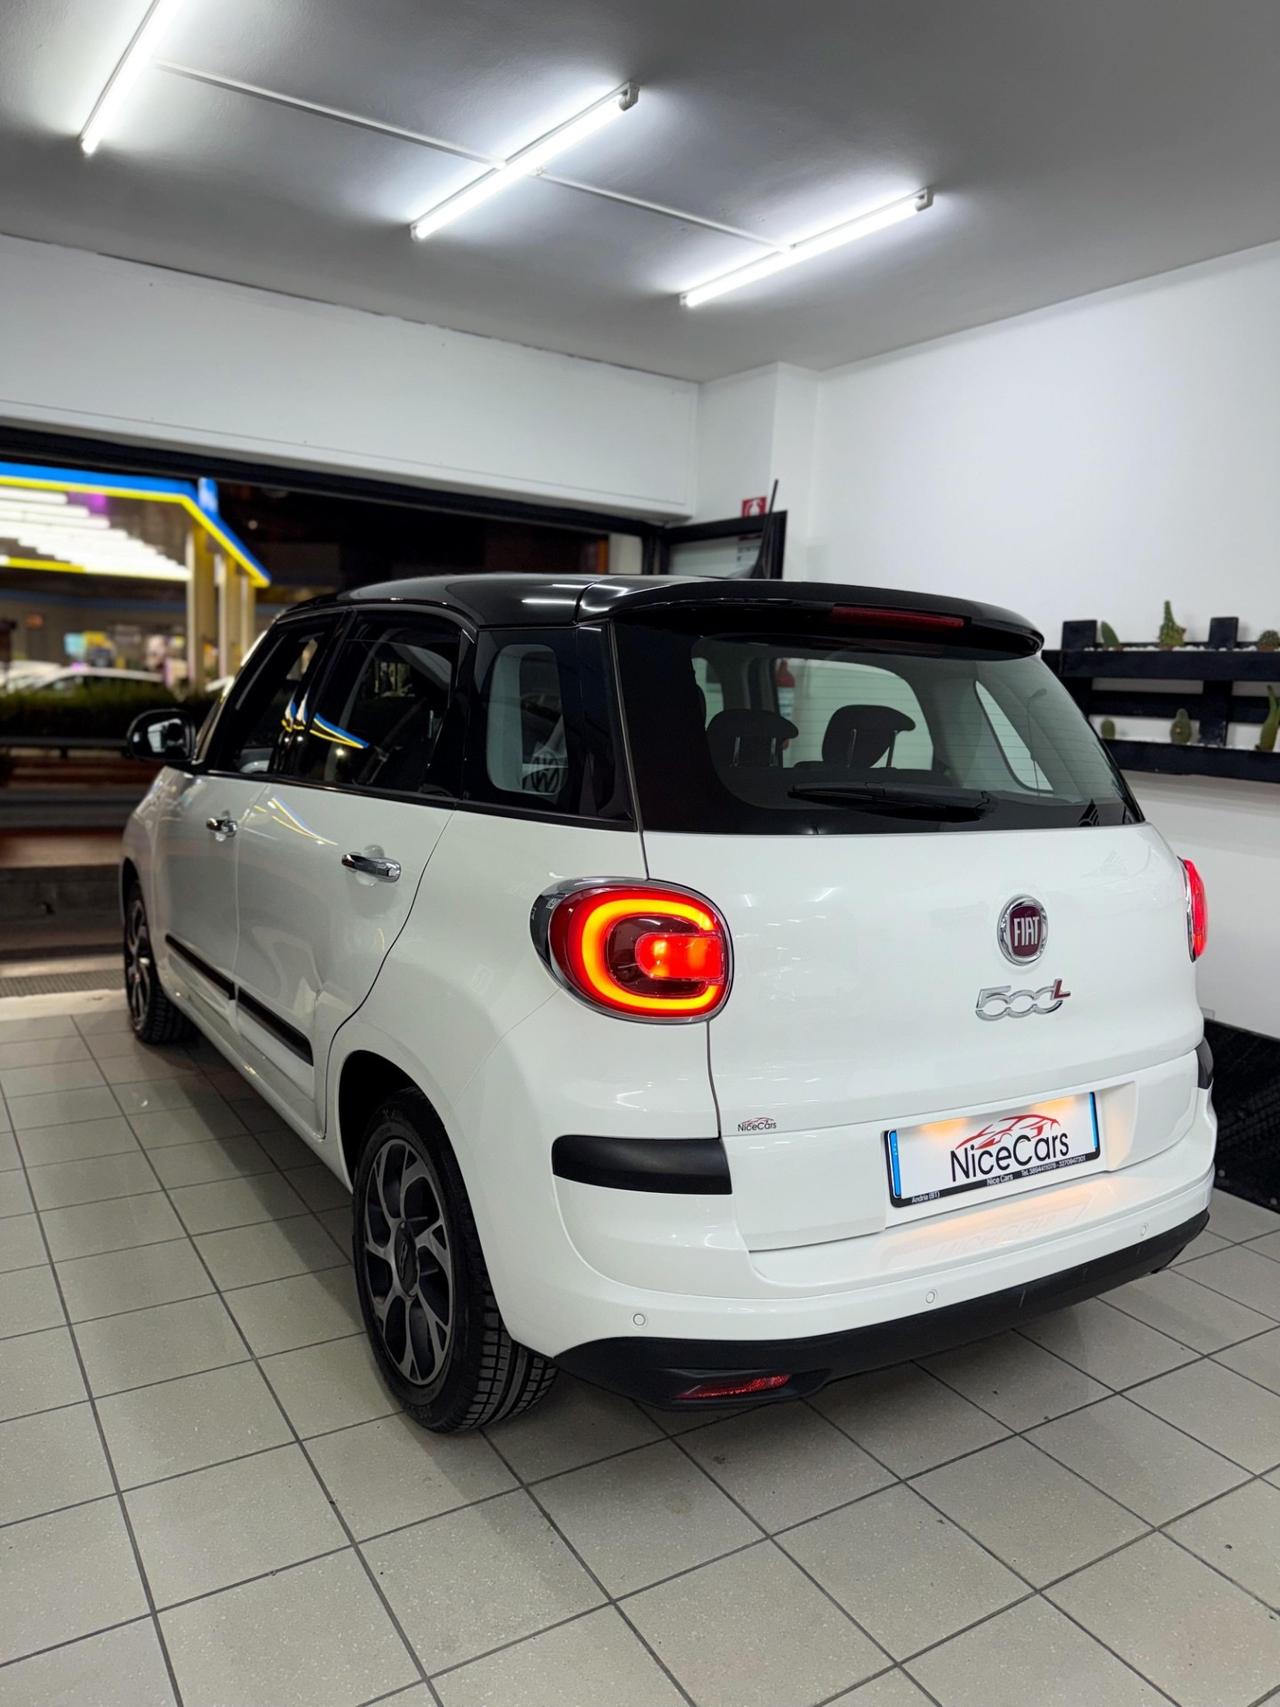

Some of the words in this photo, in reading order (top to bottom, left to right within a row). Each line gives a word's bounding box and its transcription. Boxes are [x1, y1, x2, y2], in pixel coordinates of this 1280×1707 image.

[1013, 916, 1040, 946] FIAT
[975, 978, 1071, 1021] 500L
[737, 1122, 777, 1132] NiceCars
[950, 1132, 1070, 1182] NiceCars
[986, 1177, 1001, 1186] Nice
[1001, 1174, 1014, 1184] Cars
[912, 1194, 928, 1203] Andria
